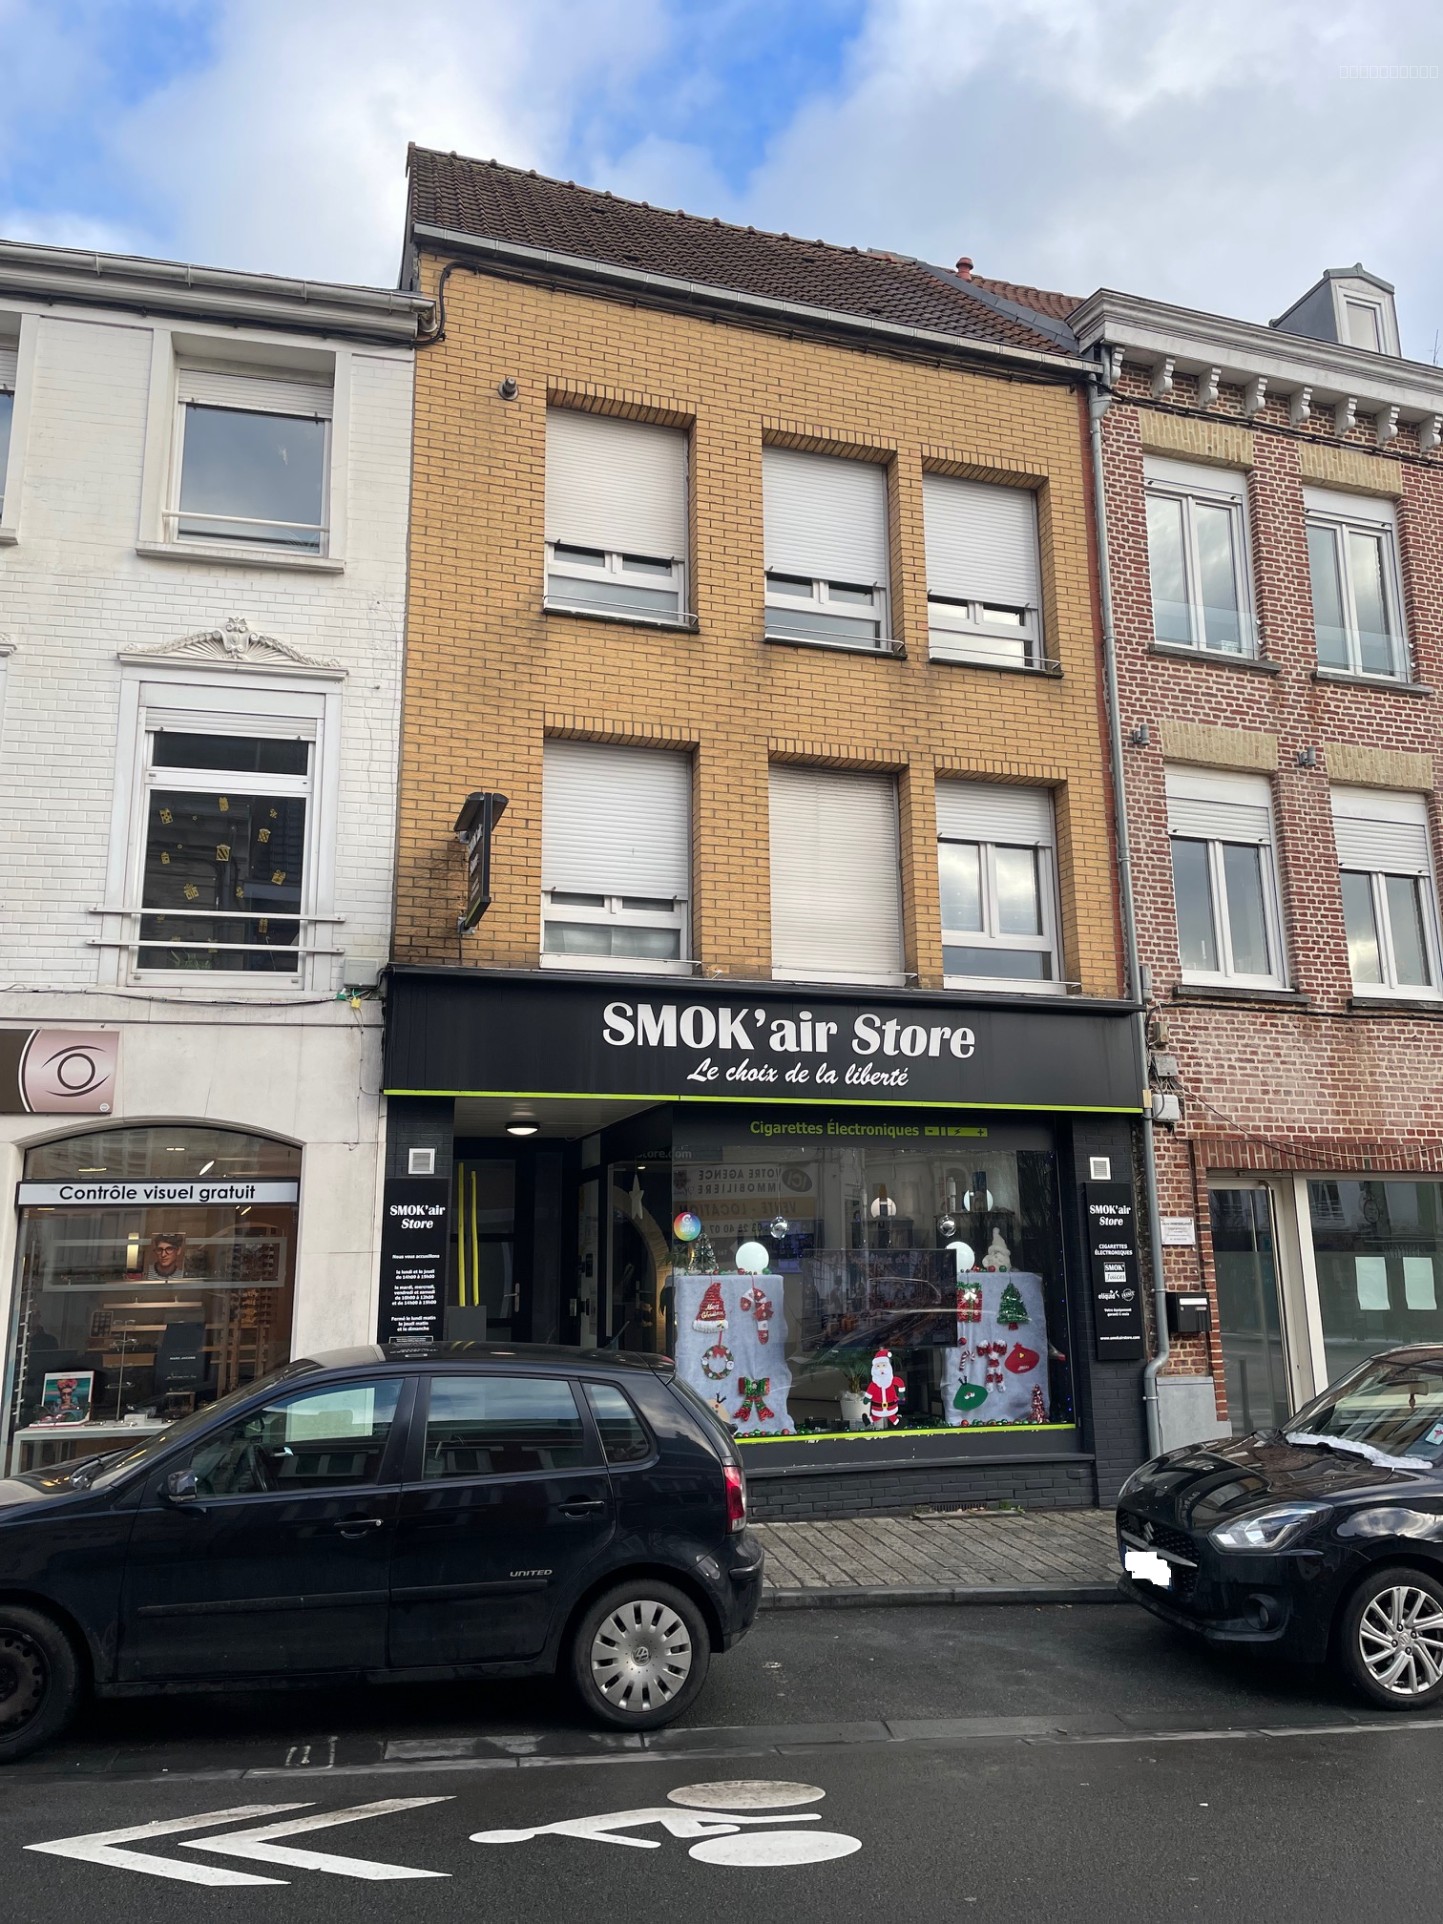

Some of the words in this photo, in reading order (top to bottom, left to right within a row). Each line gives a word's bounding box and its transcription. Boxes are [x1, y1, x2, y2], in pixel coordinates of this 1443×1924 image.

[851, 1013, 976, 1058] Store
[687, 1058, 719, 1082] Le
[725, 1063, 779, 1083] choix
[785, 1063, 810, 1084] de
[815, 1065, 838, 1085] la
[845, 1063, 909, 1087] liberté
[750, 1121, 824, 1137] Cigarettes
[827, 1118, 919, 1138] Électroniques
[59, 1185, 137, 1200] Contrôle
[143, 1185, 193, 1200] visuel
[199, 1185, 256, 1202] gratuit
[401, 1218, 434, 1229] Store
[1099, 1216, 1124, 1226] Store
[509, 1569, 553, 1577] UNITED
